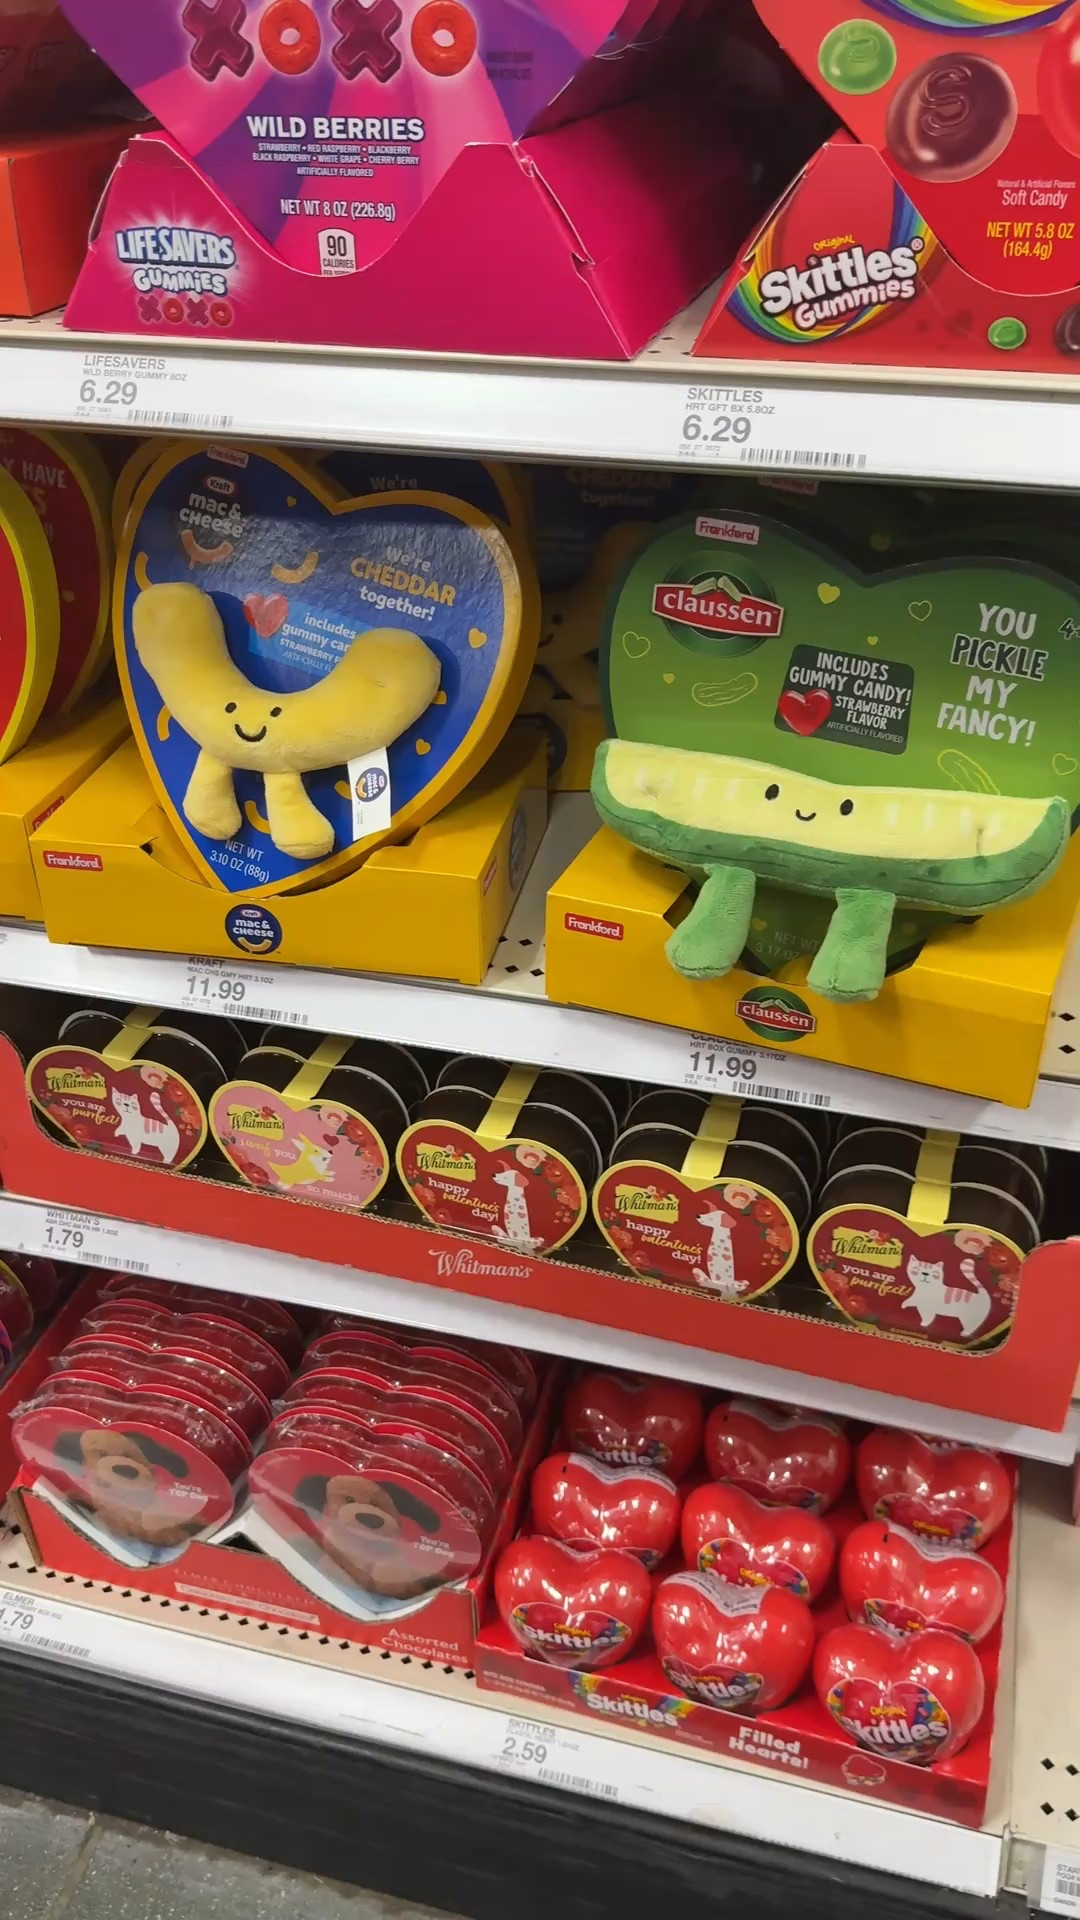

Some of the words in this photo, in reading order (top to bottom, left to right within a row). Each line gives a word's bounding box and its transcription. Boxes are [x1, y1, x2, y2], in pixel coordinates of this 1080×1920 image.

[247, 116, 306, 137] WILD
[314, 117, 424, 140] BERRIES
[253, 153, 272, 161] BLACK
[274, 154, 311, 162] RASPBERRY
[318, 155, 338, 163] WHITE
[339, 155, 362, 163] GRAPE
[368, 156, 395, 164] CHERRY
[396, 157, 419, 165] BERRY
[258, 143, 300, 151] STRAWBERRY
[307, 144, 321, 152] RED
[322, 144, 361, 153] RASPBERRY
[368, 145, 411, 154] BLACKBERRY
[297, 167, 338, 176] ARTIFICIALLY
[339, 168, 373, 177] FLAVORED
[1002, 189, 1027, 206] Soft
[1030, 189, 1068, 209] Candy
[280, 199, 301, 214] NET
[304, 200, 320, 215] WT
[324, 201, 330, 215] 8
[334, 201, 348, 216] OZ
[351, 203, 395, 221] (226.8g)
[987, 221, 1011, 237] NET
[1014, 222, 1033, 238] WT
[1035, 223, 1054, 238] 5.8
[1057, 223, 1075, 239] OZ
[327, 235, 347, 256] 90
[1003, 239, 1052, 260] (164.4g)
[323, 258, 354, 269] CALORIES
[795, 278, 916, 330] Gummies
[84, 355, 166, 370] LIFESAVERS
[82, 368, 101, 376] WLD
[103, 369, 132, 378] BERRY
[134, 371, 168, 381] GUMMY
[79, 379, 137, 406] 6.29
[687, 388, 763, 403] SKITTLES
[685, 403, 706, 411] HRT
[708, 404, 727, 412] GFT
[731, 405, 744, 413] BX
[747, 405, 775, 414] 5.8OZ
[682, 414, 751, 443] 6.29
[22, 460, 67, 489] HAVE
[210, 480, 231, 493] Kraft
[189, 493, 227, 515] mac
[228, 503, 241, 520] &
[699, 520, 756, 541] Frankford
[387, 546, 431, 572] We're
[350, 557, 457, 605] CHEDDAR
[360, 585, 436, 622] together!
[663, 592, 771, 626] claussen
[304, 612, 356, 640] includes
[979, 602, 1037, 640] YOU
[281, 624, 329, 648] gummy
[280, 638, 333, 662] STRAWBERRY
[282, 651, 324, 669] ARTIFICIALLY
[951, 634, 1048, 681] PICKLE
[817, 652, 889, 681] INCLUDES
[789, 666, 848, 691] GUMMY
[853, 679, 911, 706] CANDY!
[966, 675, 1018, 708] MY
[835, 695, 906, 720] STRAWBERRY
[846, 710, 888, 729] FLAVOR
[937, 703, 1037, 747] FANCY!
[827, 721, 869, 736] ARTIFICIALLY
[869, 728, 904, 743] FLAVORED
[46, 854, 101, 869] Frankford
[225, 840, 244, 854] NET
[247, 848, 264, 862] WT
[210, 850, 228, 866] 3.10
[230, 858, 244, 871] OZ
[244, 864, 270, 883] (88g)
[235, 919, 260, 929] mac
[261, 920, 270, 929] &
[568, 917, 622, 938] Frankford
[775, 931, 796, 945] NET
[187, 966, 202, 974] MAC
[205, 968, 219, 976] CHS
[221, 971, 237, 980] GMY
[189, 957, 226, 969] KRAFT
[187, 975, 245, 1001] 11.99
[742, 1004, 809, 1028] claussen
[708, 1044, 724, 1052] BOX
[726, 1046, 757, 1057] GUMMY
[690, 1051, 757, 1080] 11.99
[61, 1097, 85, 1109] you
[87, 1102, 106, 1112] are
[72, 1107, 120, 1125] purrfect!
[227, 1112, 284, 1130] Whitman's
[273, 1149, 297, 1160] you
[306, 1185, 319, 1194] so
[323, 1187, 361, 1203] much!
[428, 1177, 470, 1196] happy
[443, 1191, 500, 1212] valentine's
[46, 1209, 100, 1225] WHITMAN'S
[472, 1208, 499, 1222] day!
[45, 1226, 84, 1248] 1.79
[625, 1218, 671, 1239] happy
[641, 1233, 703, 1255] valentine's
[428, 1249, 533, 1278] Whitman's
[672, 1250, 702, 1265] day!
[842, 1264, 871, 1278] you
[872, 1271, 895, 1283] are
[850, 1277, 915, 1297] purrfect!
[3, 1592, 35, 1605] ELMER
[388, 1628, 459, 1651] Assorted
[381, 1637, 469, 1664] Chocolates
[587, 1692, 678, 1727] Skittles
[508, 1718, 556, 1736] SKITTLES
[738, 1725, 801, 1754] Filled
[502, 1737, 547, 1764] 2.59
[729, 1737, 808, 1769] Hearts!
